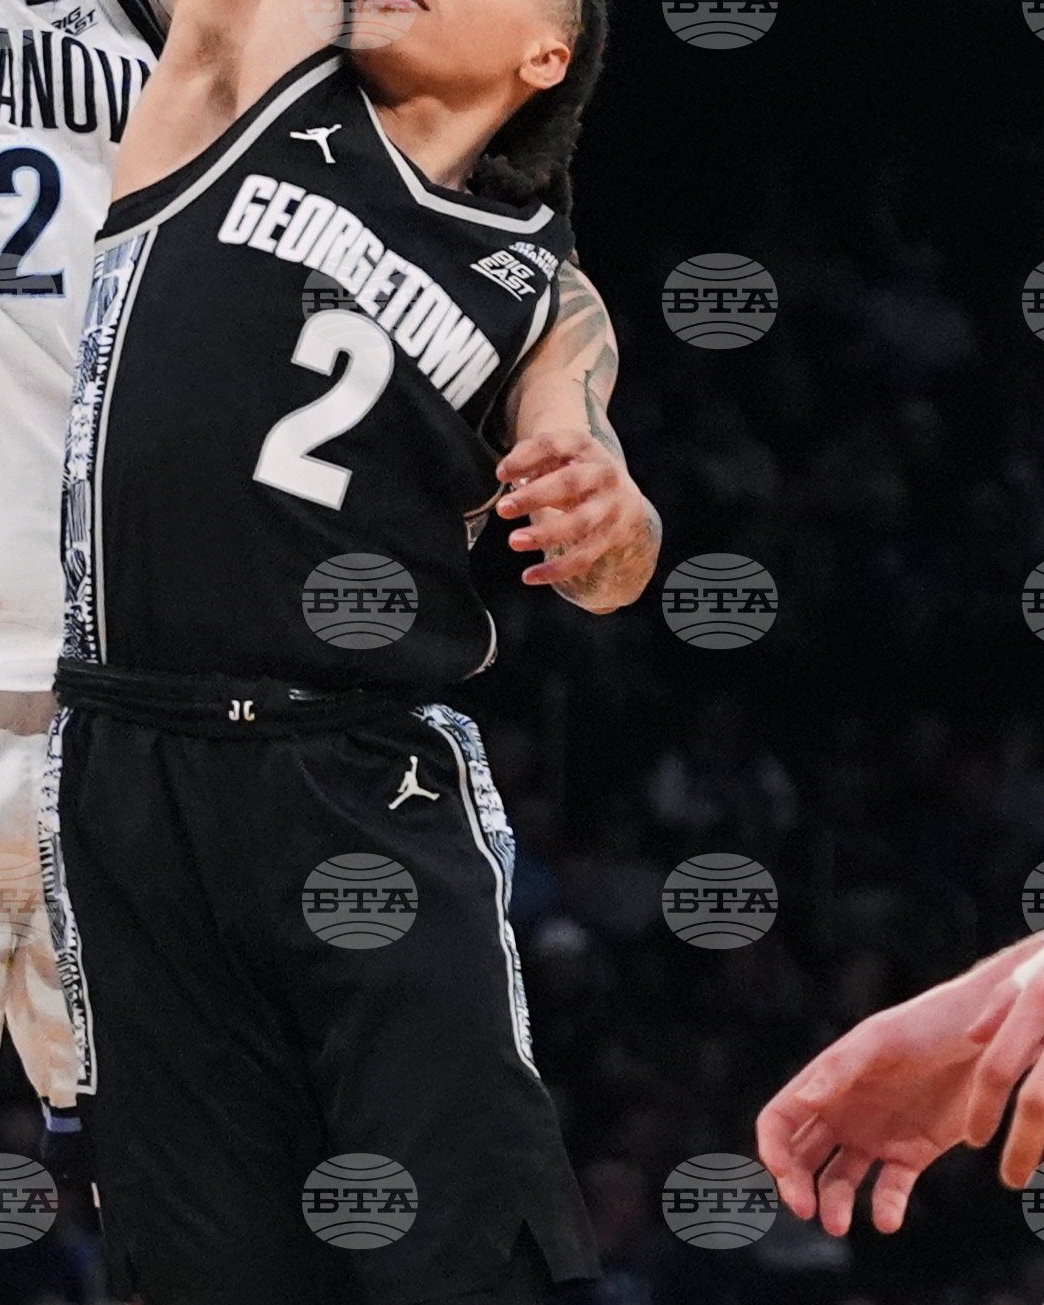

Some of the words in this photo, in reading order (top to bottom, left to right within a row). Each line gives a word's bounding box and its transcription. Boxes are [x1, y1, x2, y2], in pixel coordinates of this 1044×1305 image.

[218, 174, 500, 410] GEORGETOWN
[477, 257, 536, 295] EAST
[491, 250, 535, 279] BIG
[253, 308, 395, 511] 2
